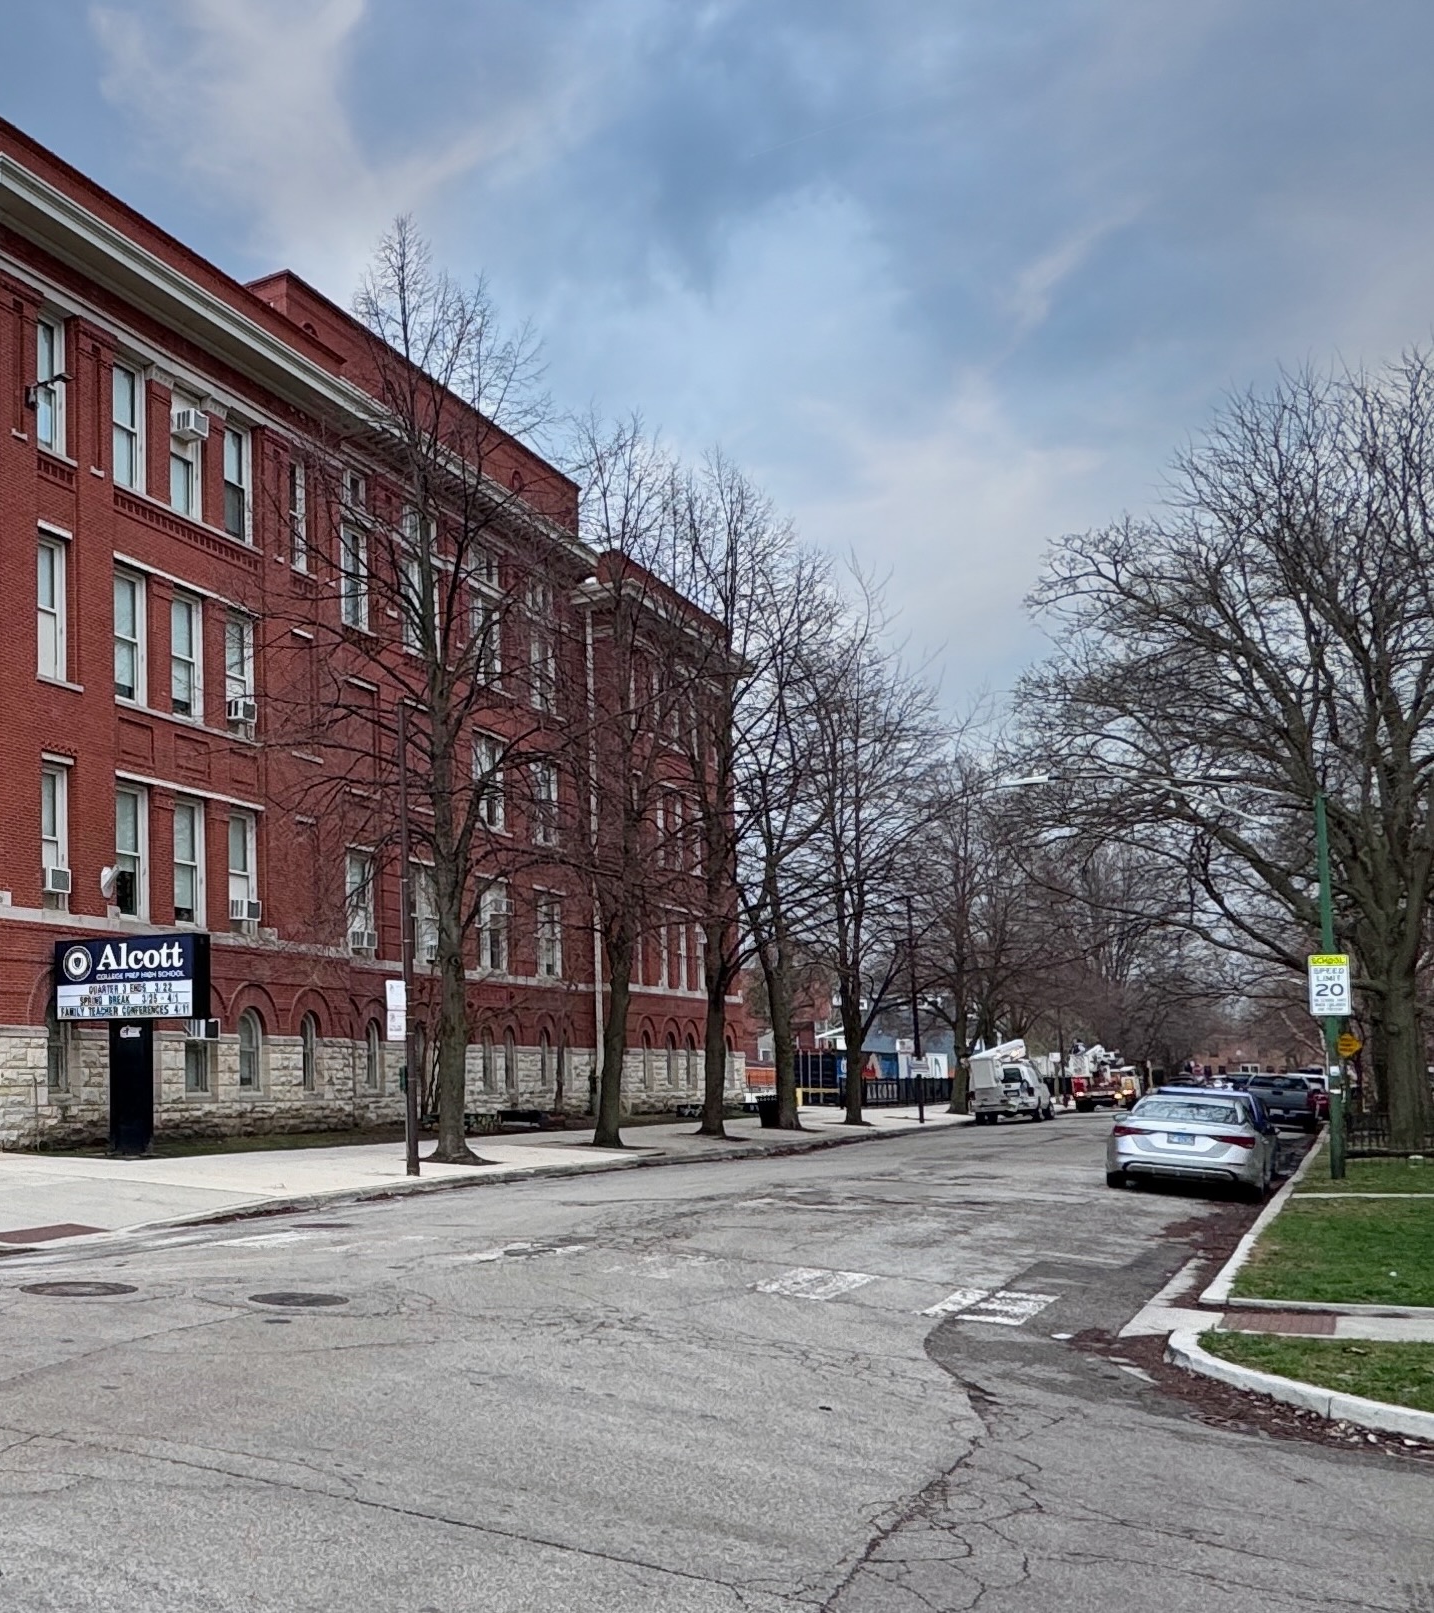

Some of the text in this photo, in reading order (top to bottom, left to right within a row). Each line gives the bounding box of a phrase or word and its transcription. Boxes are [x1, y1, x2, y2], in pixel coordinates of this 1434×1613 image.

[96, 942, 184, 971] Alcott
[88, 985, 119, 995] QUARTER
[122, 984, 127, 993] 3
[1315, 983, 1344, 997] 20
[79, 996, 103, 1006] SPRING
[108, 995, 130, 1004] BREAK
[60, 1006, 85, 1017] FAMILY
[88, 1005, 119, 1016] TEACHER
[121, 1004, 169, 1015] CONFERENCES
